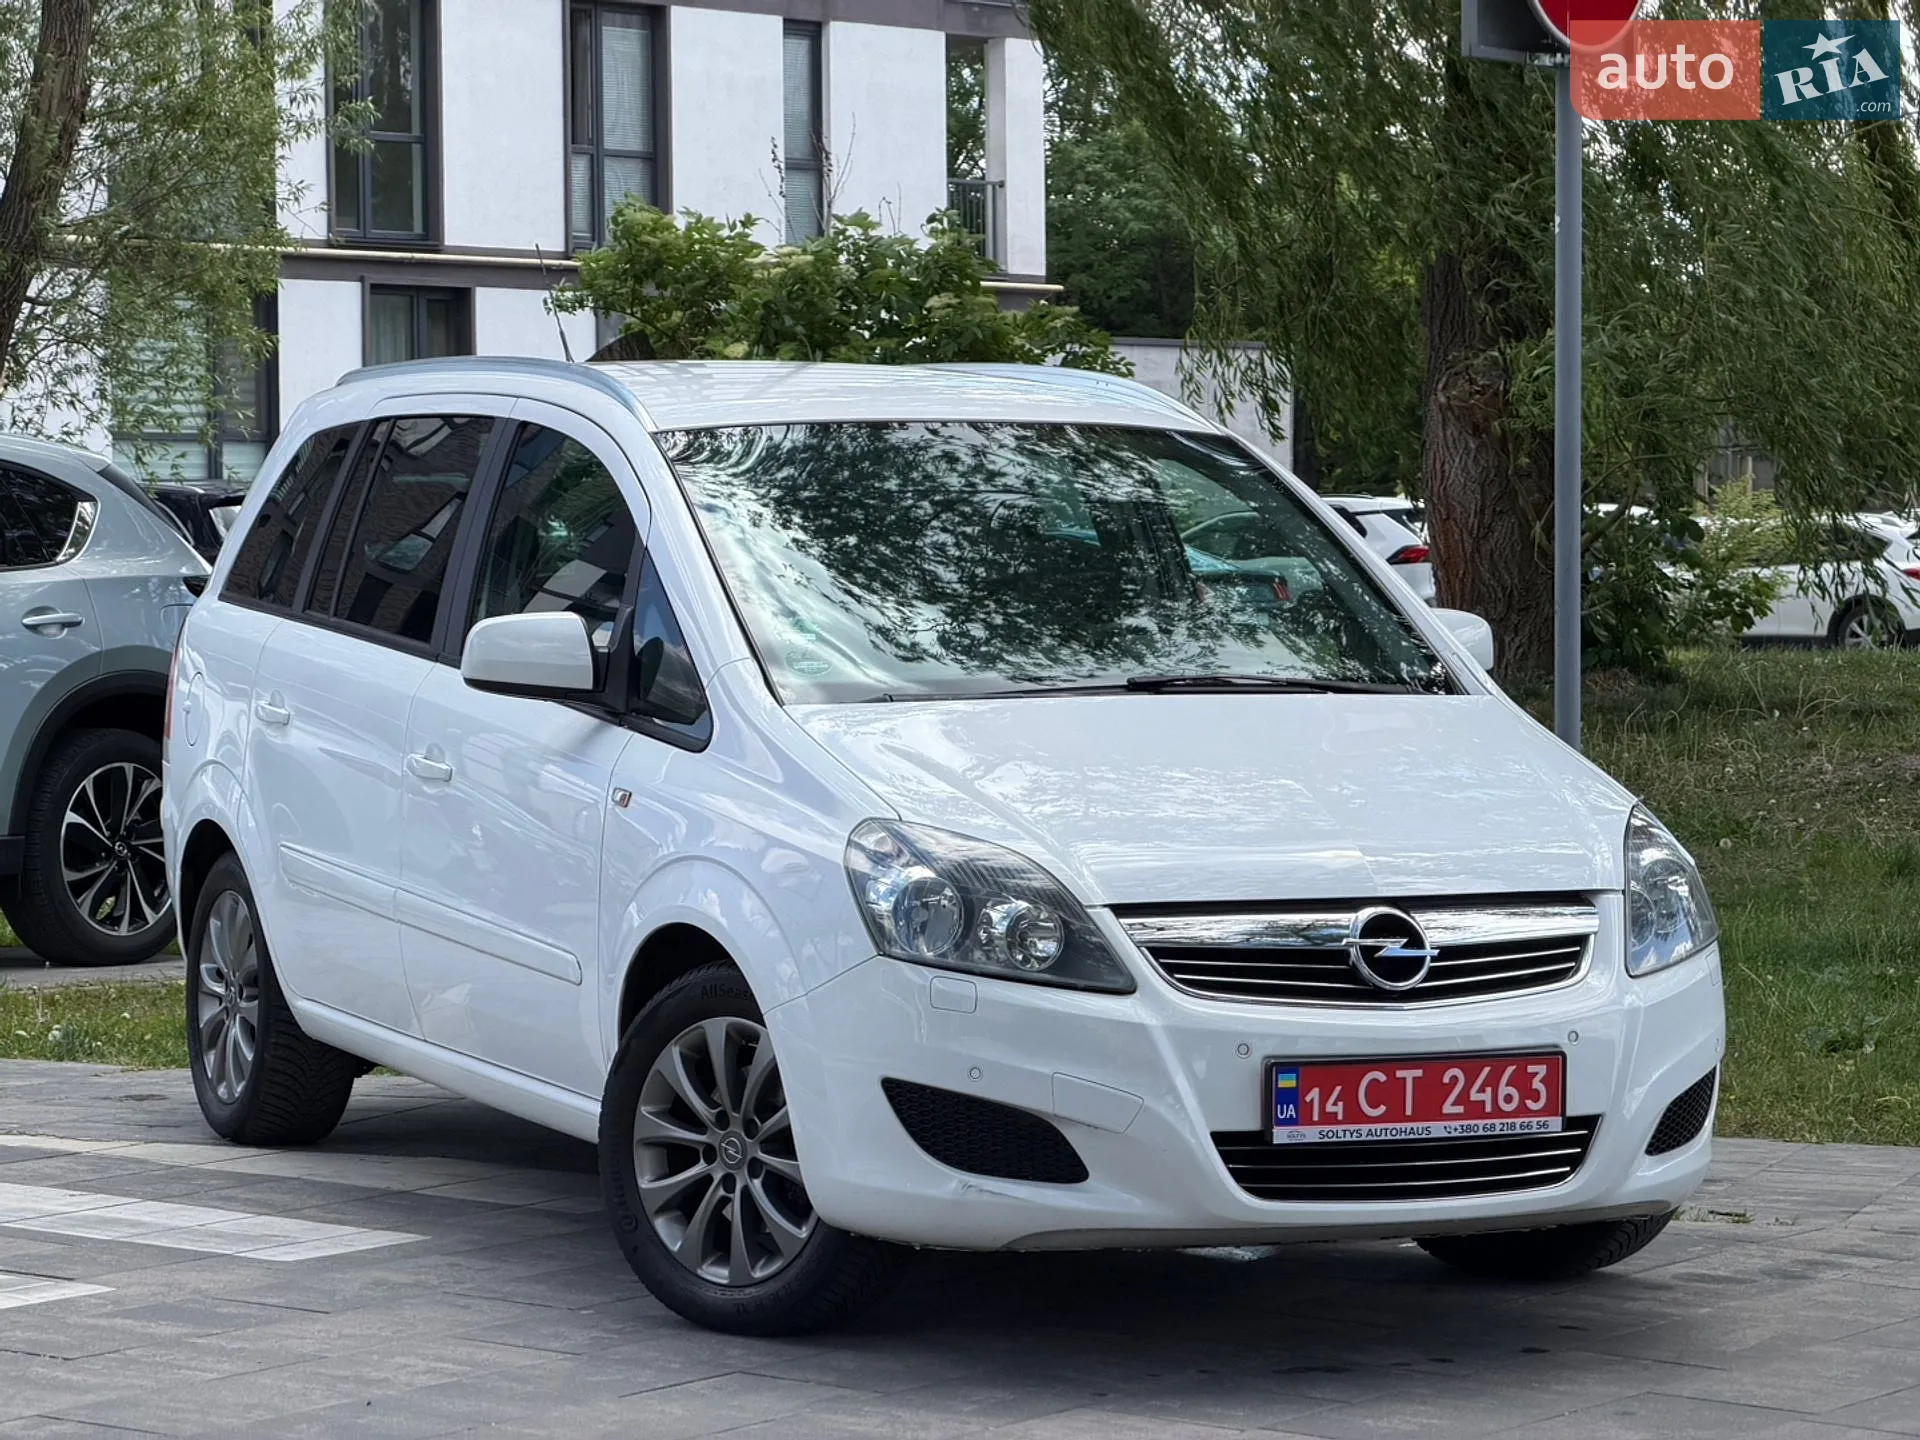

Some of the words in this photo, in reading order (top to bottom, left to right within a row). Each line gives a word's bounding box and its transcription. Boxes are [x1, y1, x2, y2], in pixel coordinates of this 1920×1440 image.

[1304, 1085, 1343, 1121] 14
[1357, 1069, 1423, 1117] CT
[1441, 1064, 1547, 1114] 2463
[1277, 1104, 1296, 1119] UA
[1318, 1129, 1363, 1140] SOLTYS
[1365, 1125, 1432, 1138] AUTOHAUS
[1453, 1123, 1479, 1134] +380
[1482, 1122, 1496, 1133] 68
[1499, 1121, 1516, 1132] 218
[1519, 1121, 1533, 1131] 66
[1536, 1120, 1549, 1130] 56
